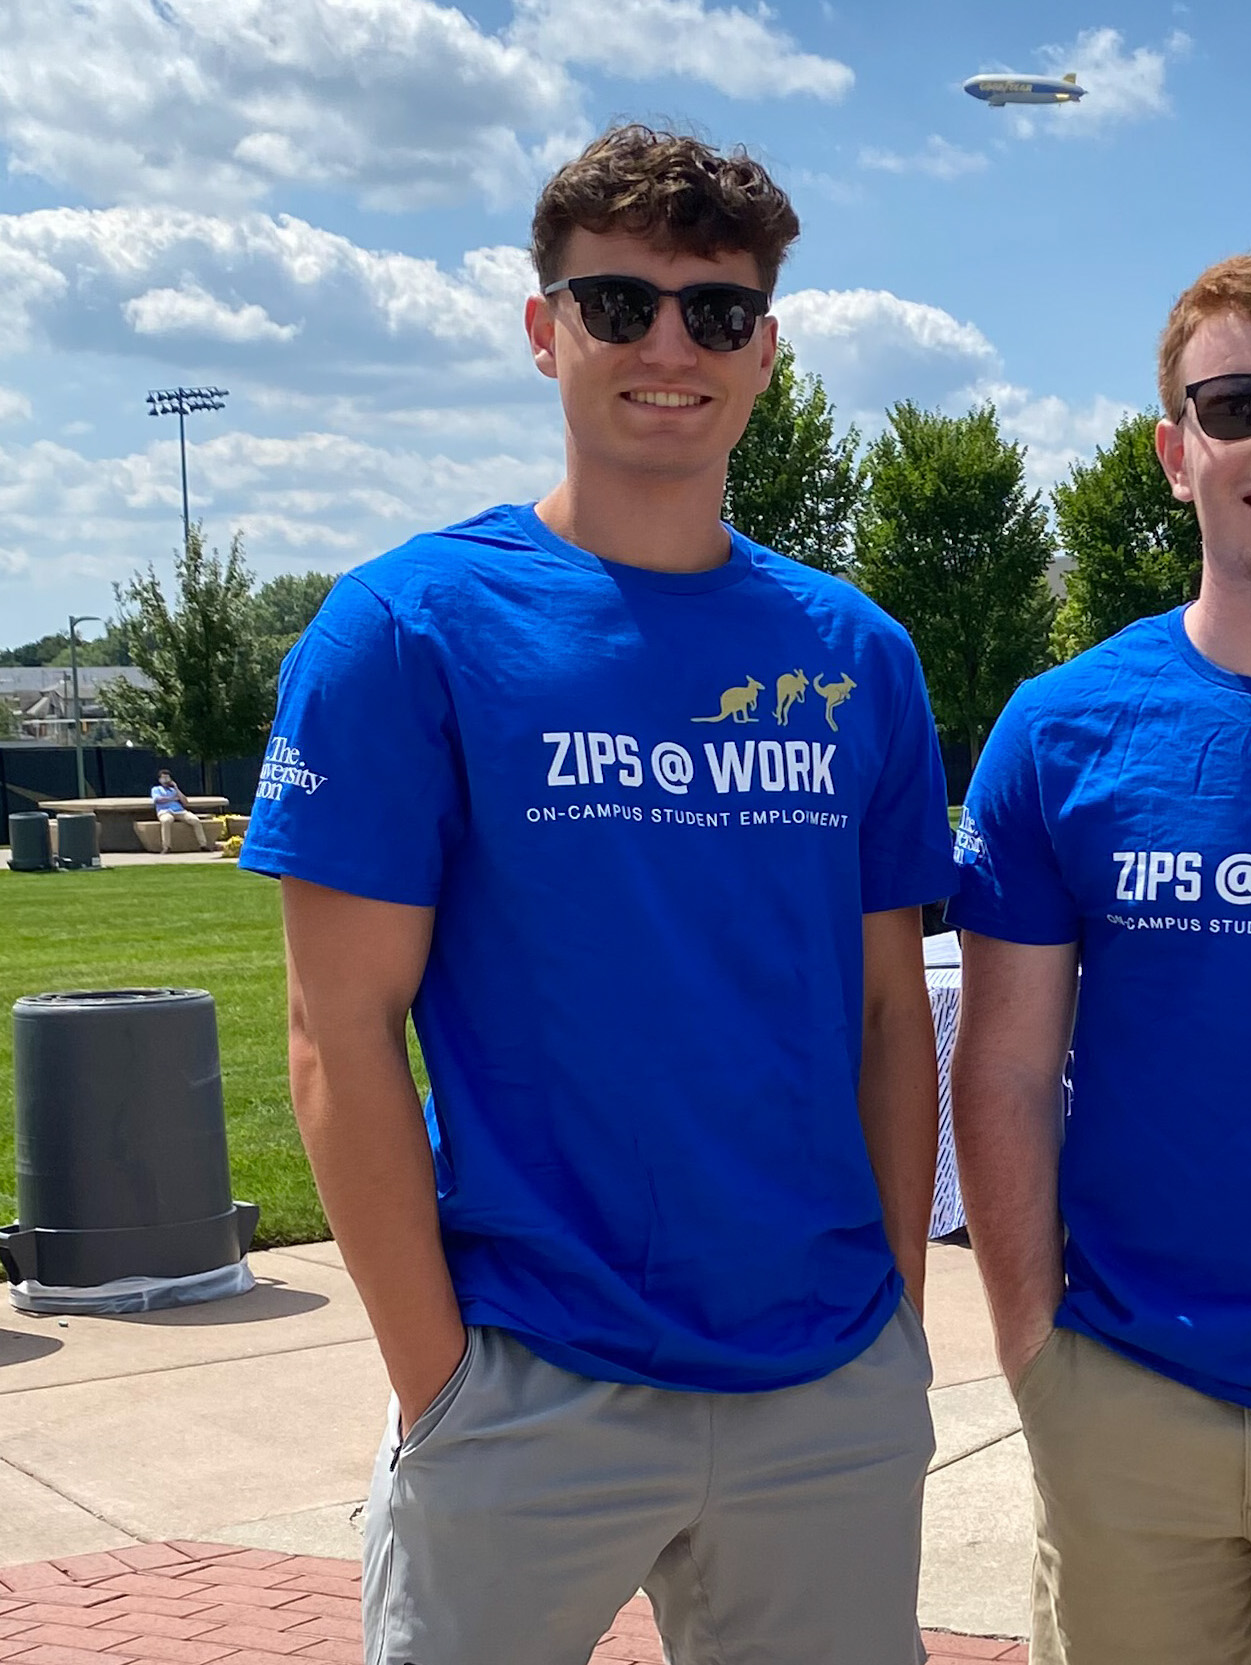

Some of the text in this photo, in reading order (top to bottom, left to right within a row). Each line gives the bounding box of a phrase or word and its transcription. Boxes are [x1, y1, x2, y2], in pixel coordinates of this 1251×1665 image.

[269, 736, 301, 765] The
[543, 732, 836, 794] ZIPS @ WORK
[260, 762, 328, 795] iversity
[527, 804, 642, 822] ON-CAMPUS
[652, 809, 730, 826] STUDENT
[1113, 852, 1201, 901] ZIPS
[1107, 914, 1201, 931] ON-CAMPUS
